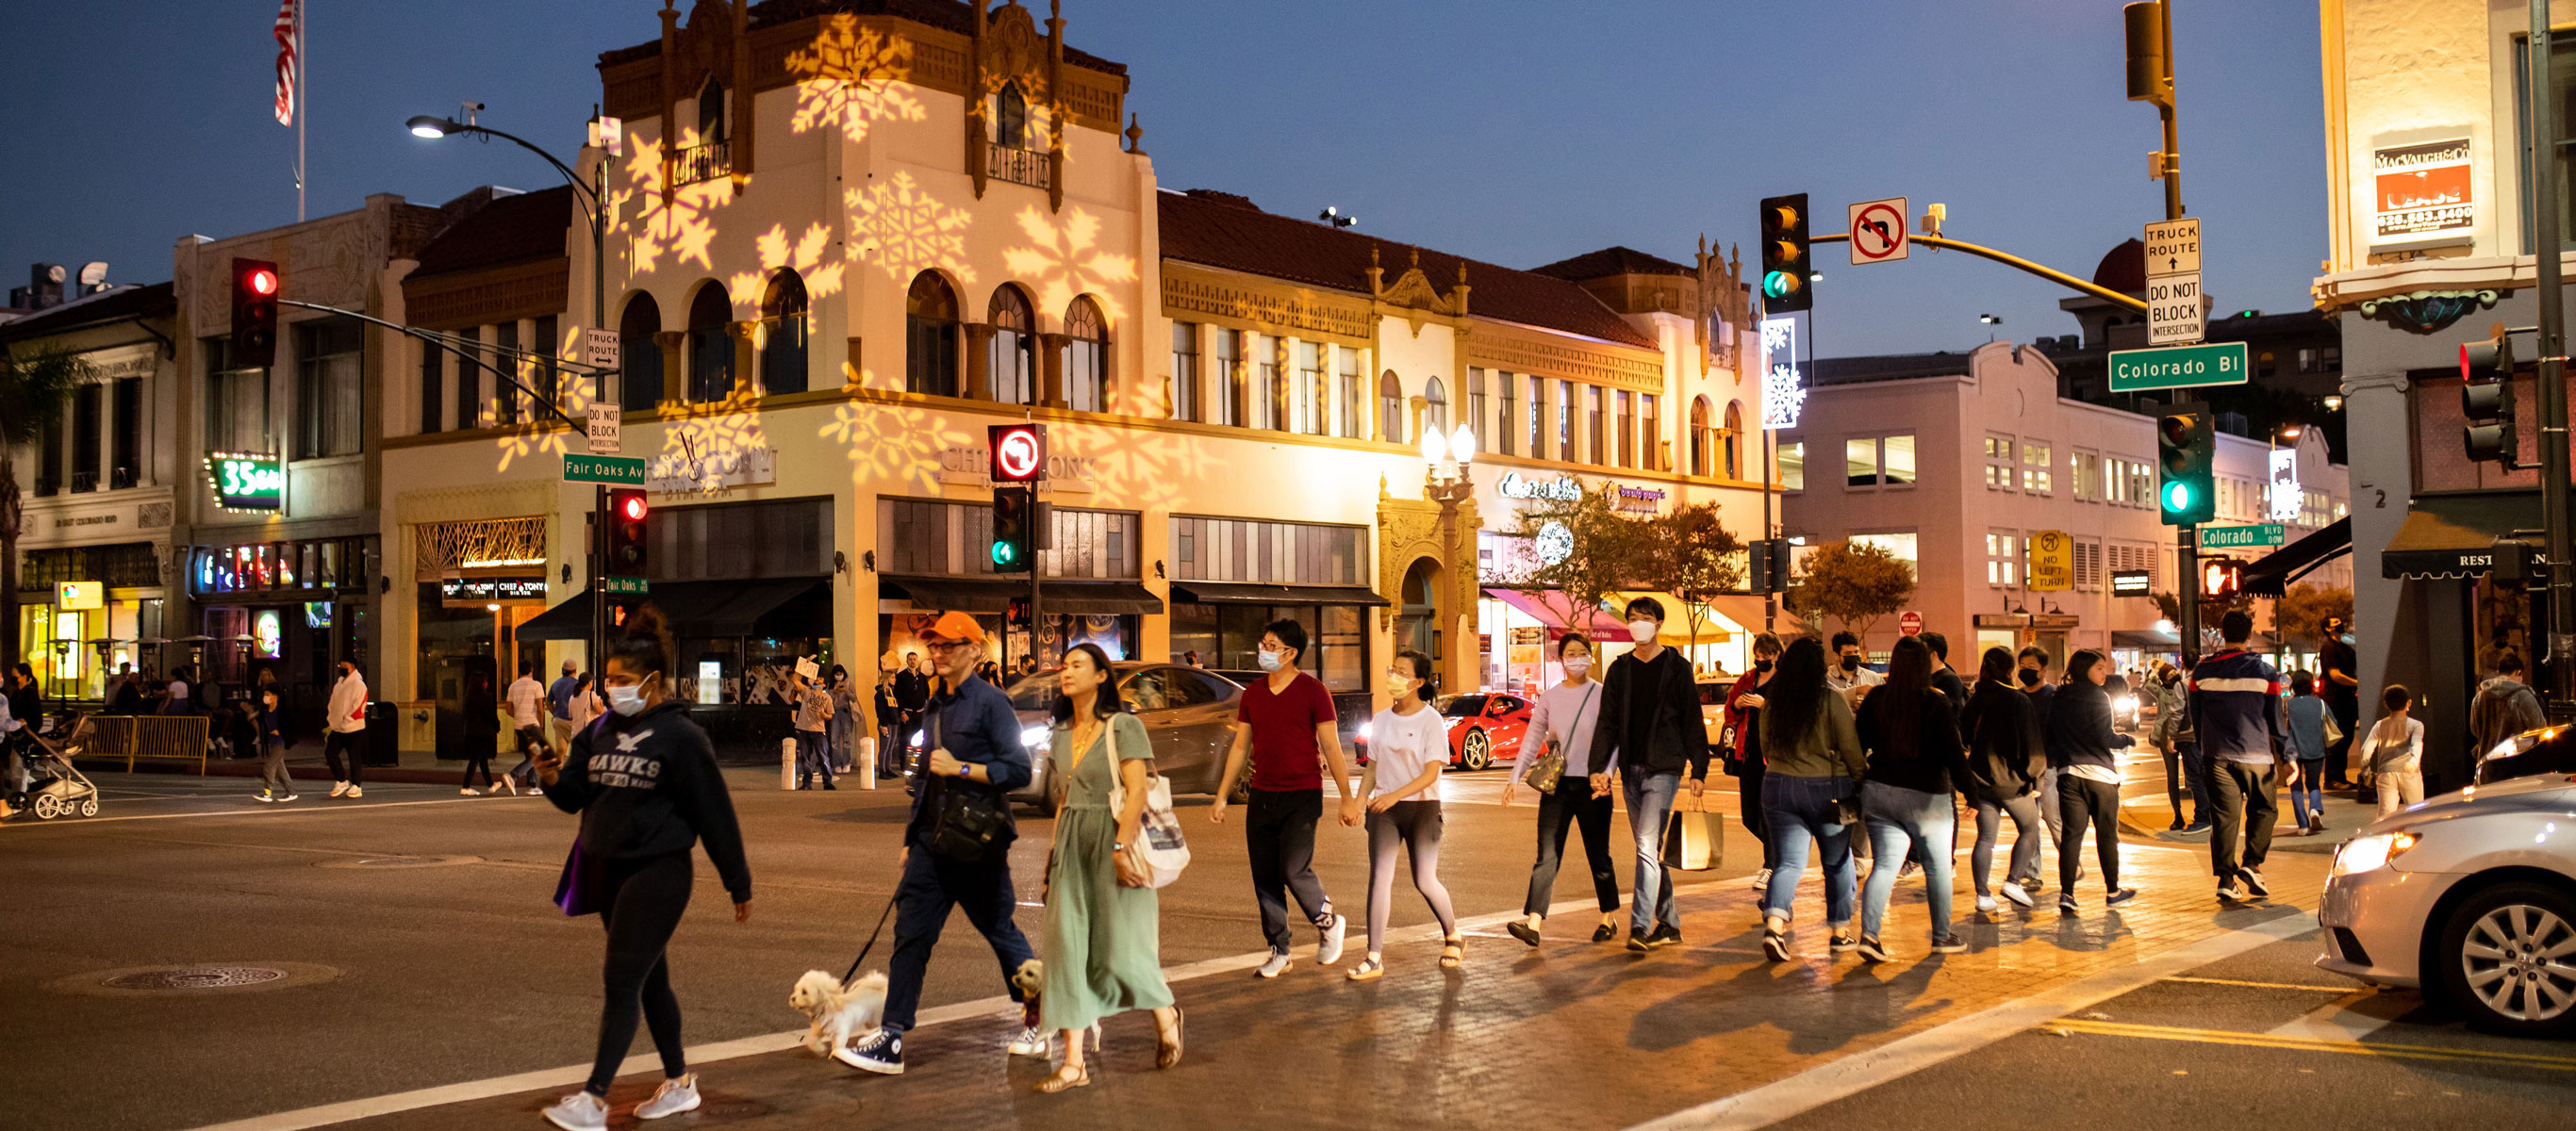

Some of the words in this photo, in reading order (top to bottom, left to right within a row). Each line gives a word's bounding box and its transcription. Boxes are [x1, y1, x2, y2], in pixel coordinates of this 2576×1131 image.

[2148, 226, 2197, 240] TRUCK
[2149, 242, 2197, 256] ROUTE
[2150, 286, 2168, 301] DO
[2173, 282, 2197, 299] NOT
[2153, 303, 2197, 321] BLOCK
[2153, 323, 2199, 336] INTERSECTION
[588, 334, 619, 344] TRUCK
[588, 346, 618, 355] ROUTE
[2118, 359, 2204, 379] Colorado
[2220, 355, 2237, 371] Bl
[589, 409, 600, 420] DO
[603, 410, 619, 421] NOT
[591, 425, 617, 436] BLOCK
[590, 439, 619, 448] INTERSECTION
[941, 447, 990, 472] CHE
[1048, 454, 1096, 480] ONY
[566, 462, 589, 475] Fair
[595, 464, 623, 477] Oaks
[629, 466, 643, 478] Av
[2375, 489, 2386, 508] 2
[2202, 530, 2254, 545] Colorado
[2264, 526, 2282, 534] BLVD
[2043, 556, 2057, 565] NO
[2039, 566, 2062, 576] LEFT
[499, 582, 517, 591] CHEF
[523, 582, 544, 591] TONY
[607, 579, 619, 591] Fair
[621, 580, 636, 591] Oaks
[2039, 578, 2064, 586] TURN
